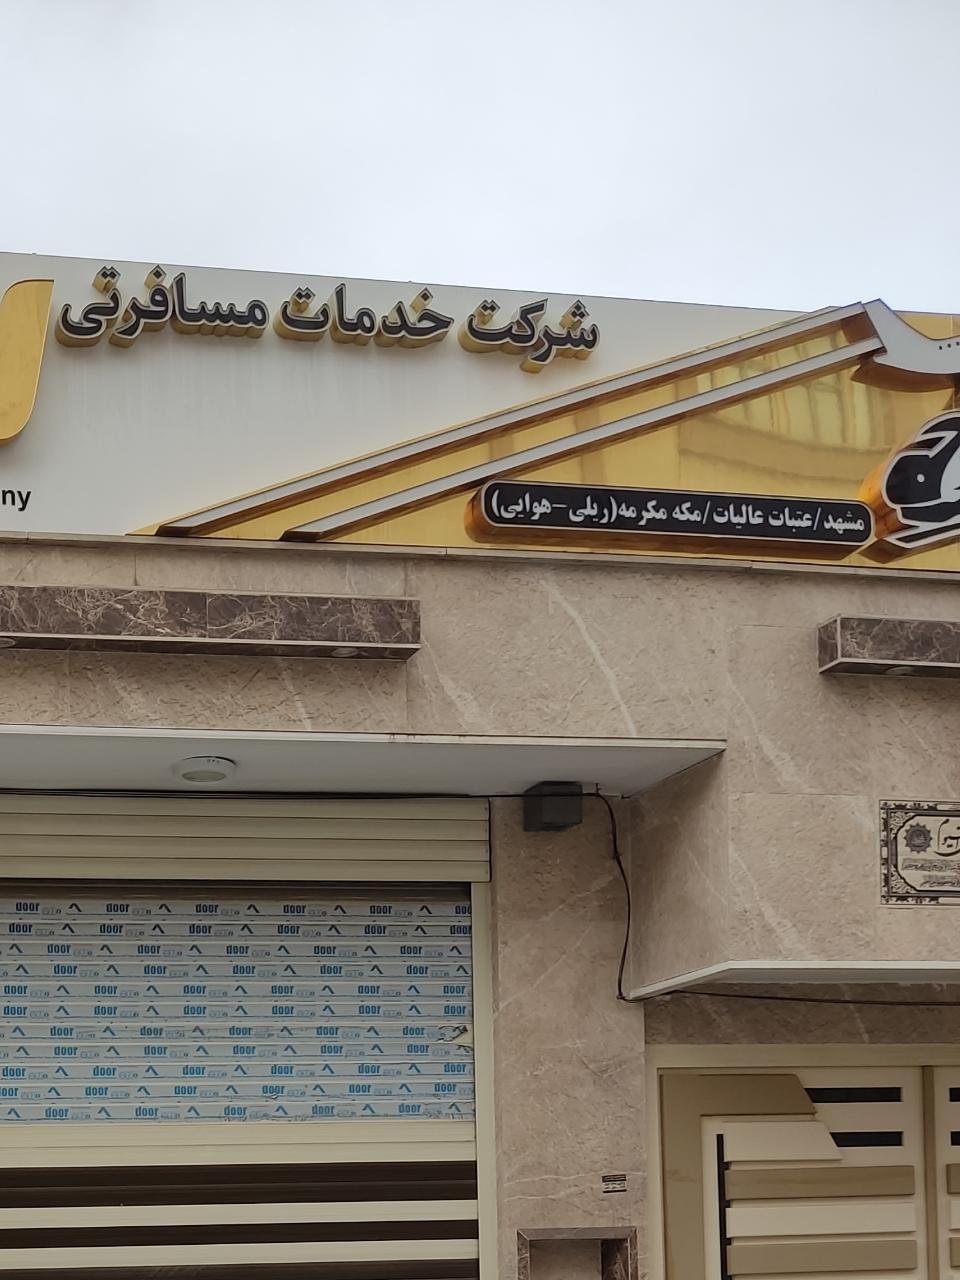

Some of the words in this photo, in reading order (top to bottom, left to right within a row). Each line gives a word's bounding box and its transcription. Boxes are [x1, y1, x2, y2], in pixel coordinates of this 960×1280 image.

[56, 265, 270, 344] مسافرتی
[277, 283, 455, 345] خدمات
[462, 298, 601, 367] شرکت
